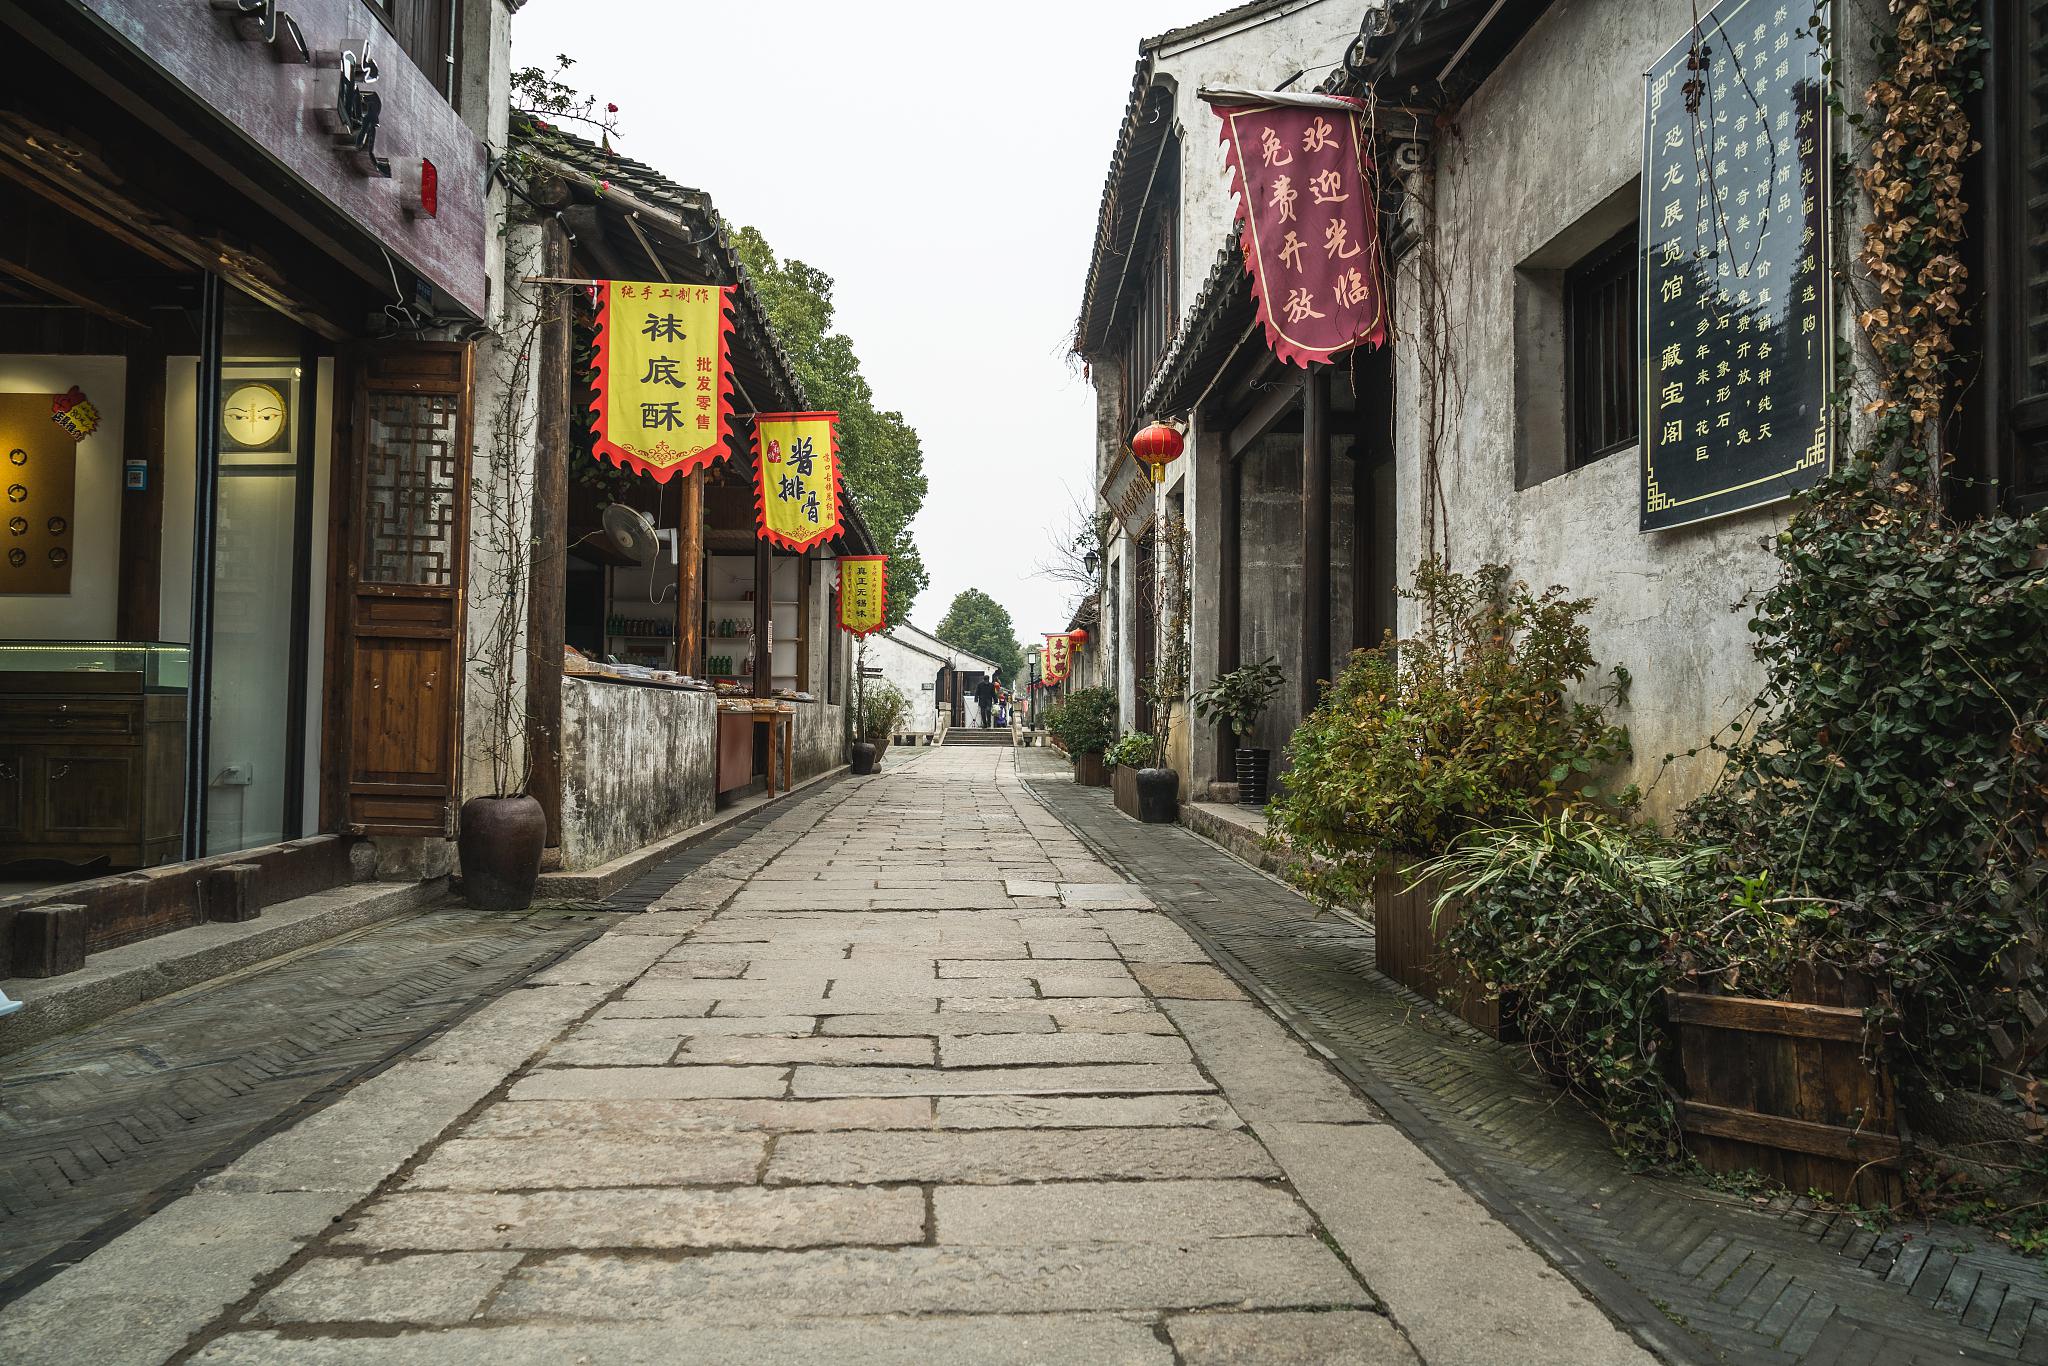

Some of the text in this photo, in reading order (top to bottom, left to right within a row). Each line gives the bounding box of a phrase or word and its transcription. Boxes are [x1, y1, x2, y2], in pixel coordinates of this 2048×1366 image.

[1259, 126, 1326, 325] 免费开放
[1302, 116, 1370, 311] 欢迎光临
[621, 285, 709, 304] 纯手工制作
[640, 313, 687, 432] 袜底酥
[695, 356, 712, 430] 批发零售
[778, 436, 820, 524] 酱排骨
